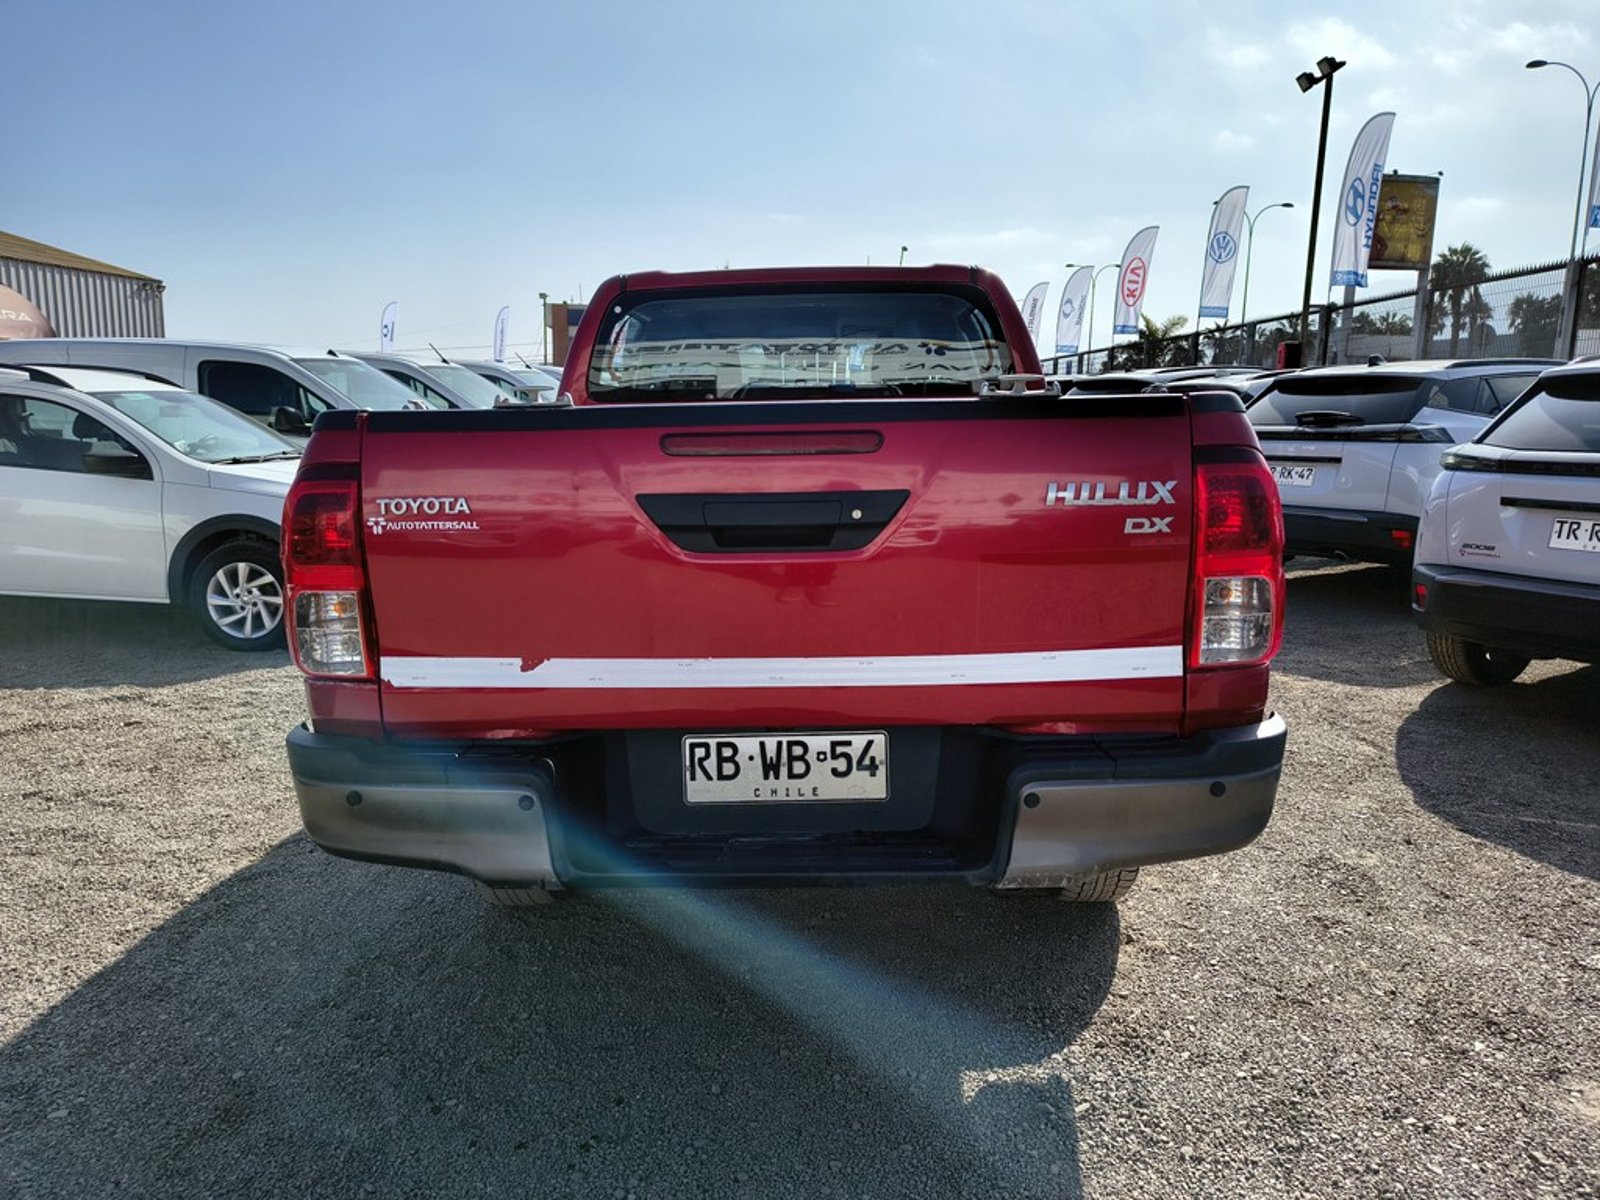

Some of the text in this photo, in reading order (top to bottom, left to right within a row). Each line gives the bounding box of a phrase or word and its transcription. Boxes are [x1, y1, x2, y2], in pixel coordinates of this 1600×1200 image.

[1362, 162, 1384, 249] HYUNDAI
[1126, 265, 1144, 299] KIA
[1045, 480, 1178, 506] HILUX
[375, 497, 471, 515] TOYOTA
[386, 520, 481, 531] AUTOTATTERSALL
[1123, 516, 1175, 534] DX
[753, 786, 820, 798] CHILE
